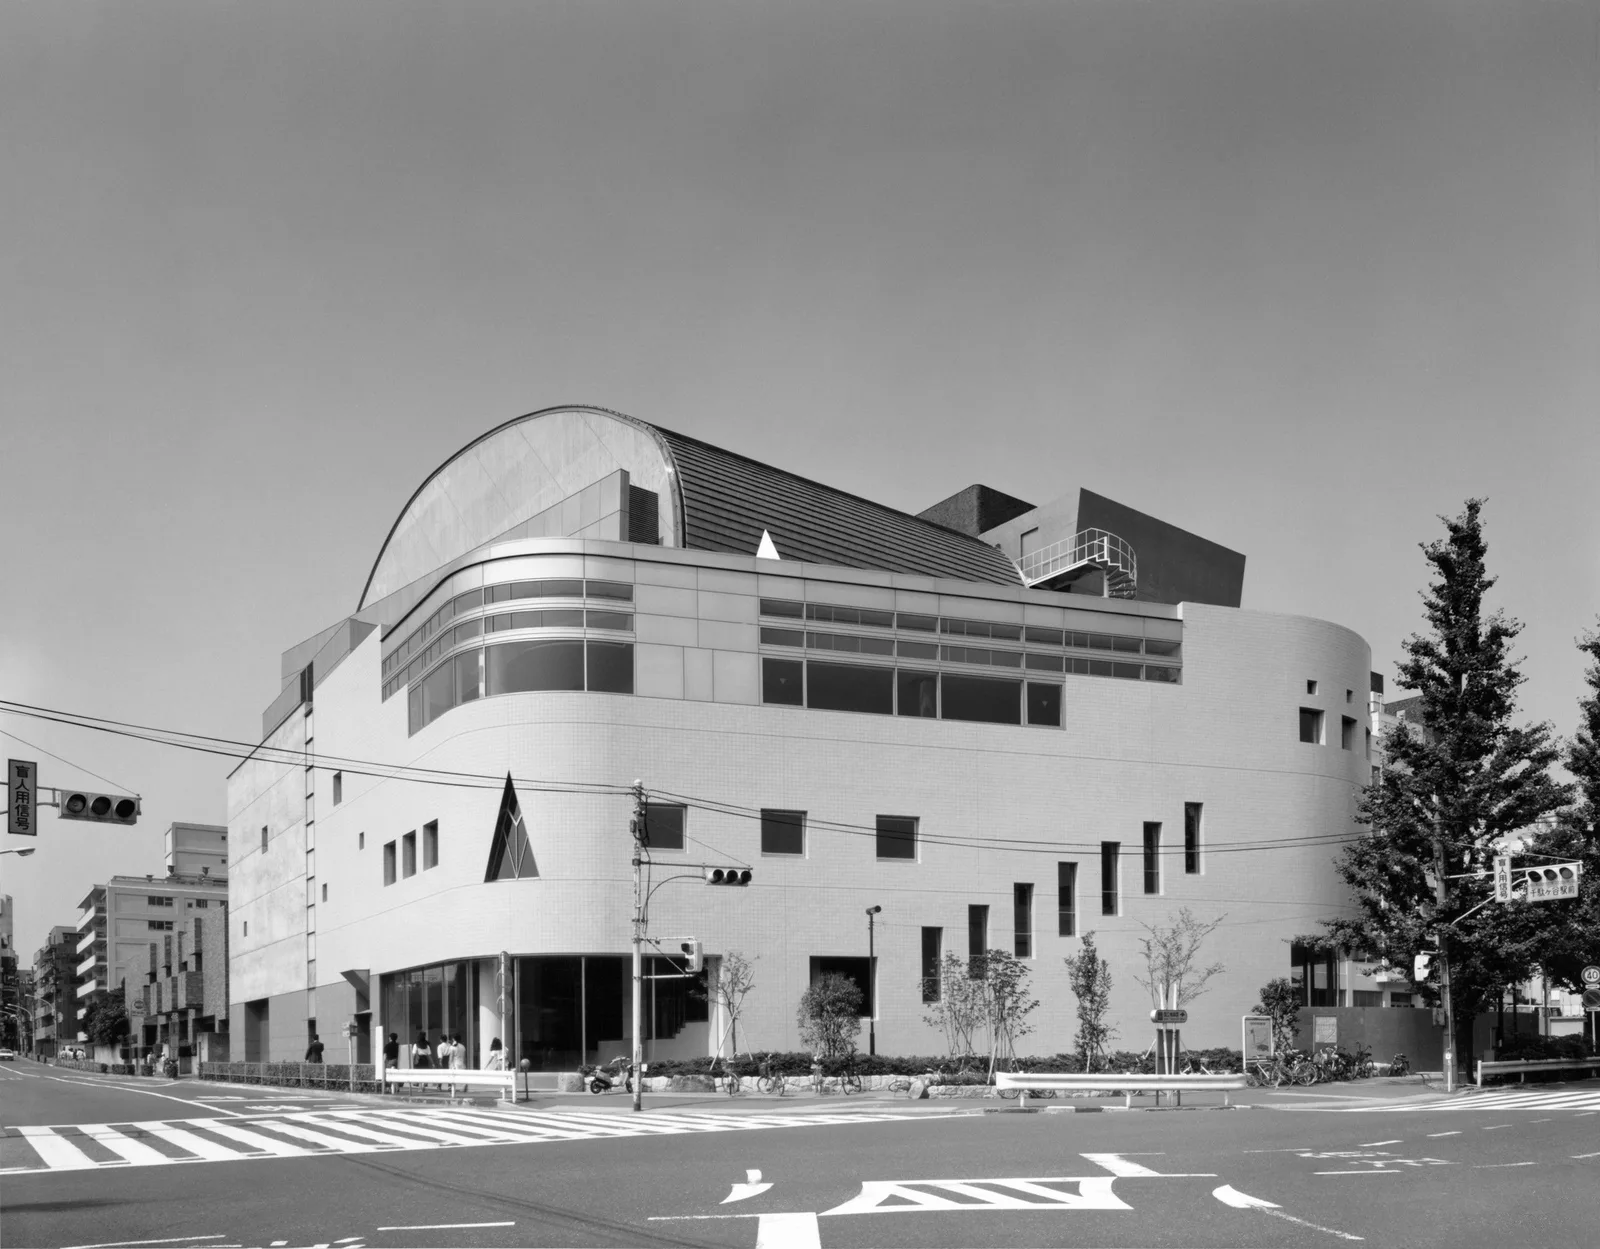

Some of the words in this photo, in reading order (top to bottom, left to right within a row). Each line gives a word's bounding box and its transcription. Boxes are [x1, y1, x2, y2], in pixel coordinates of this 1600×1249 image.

[15, 765, 30, 831] 盲人用信号
[1498, 858, 1508, 899] 盲人用信号
[1586, 970, 1599, 980] 40
